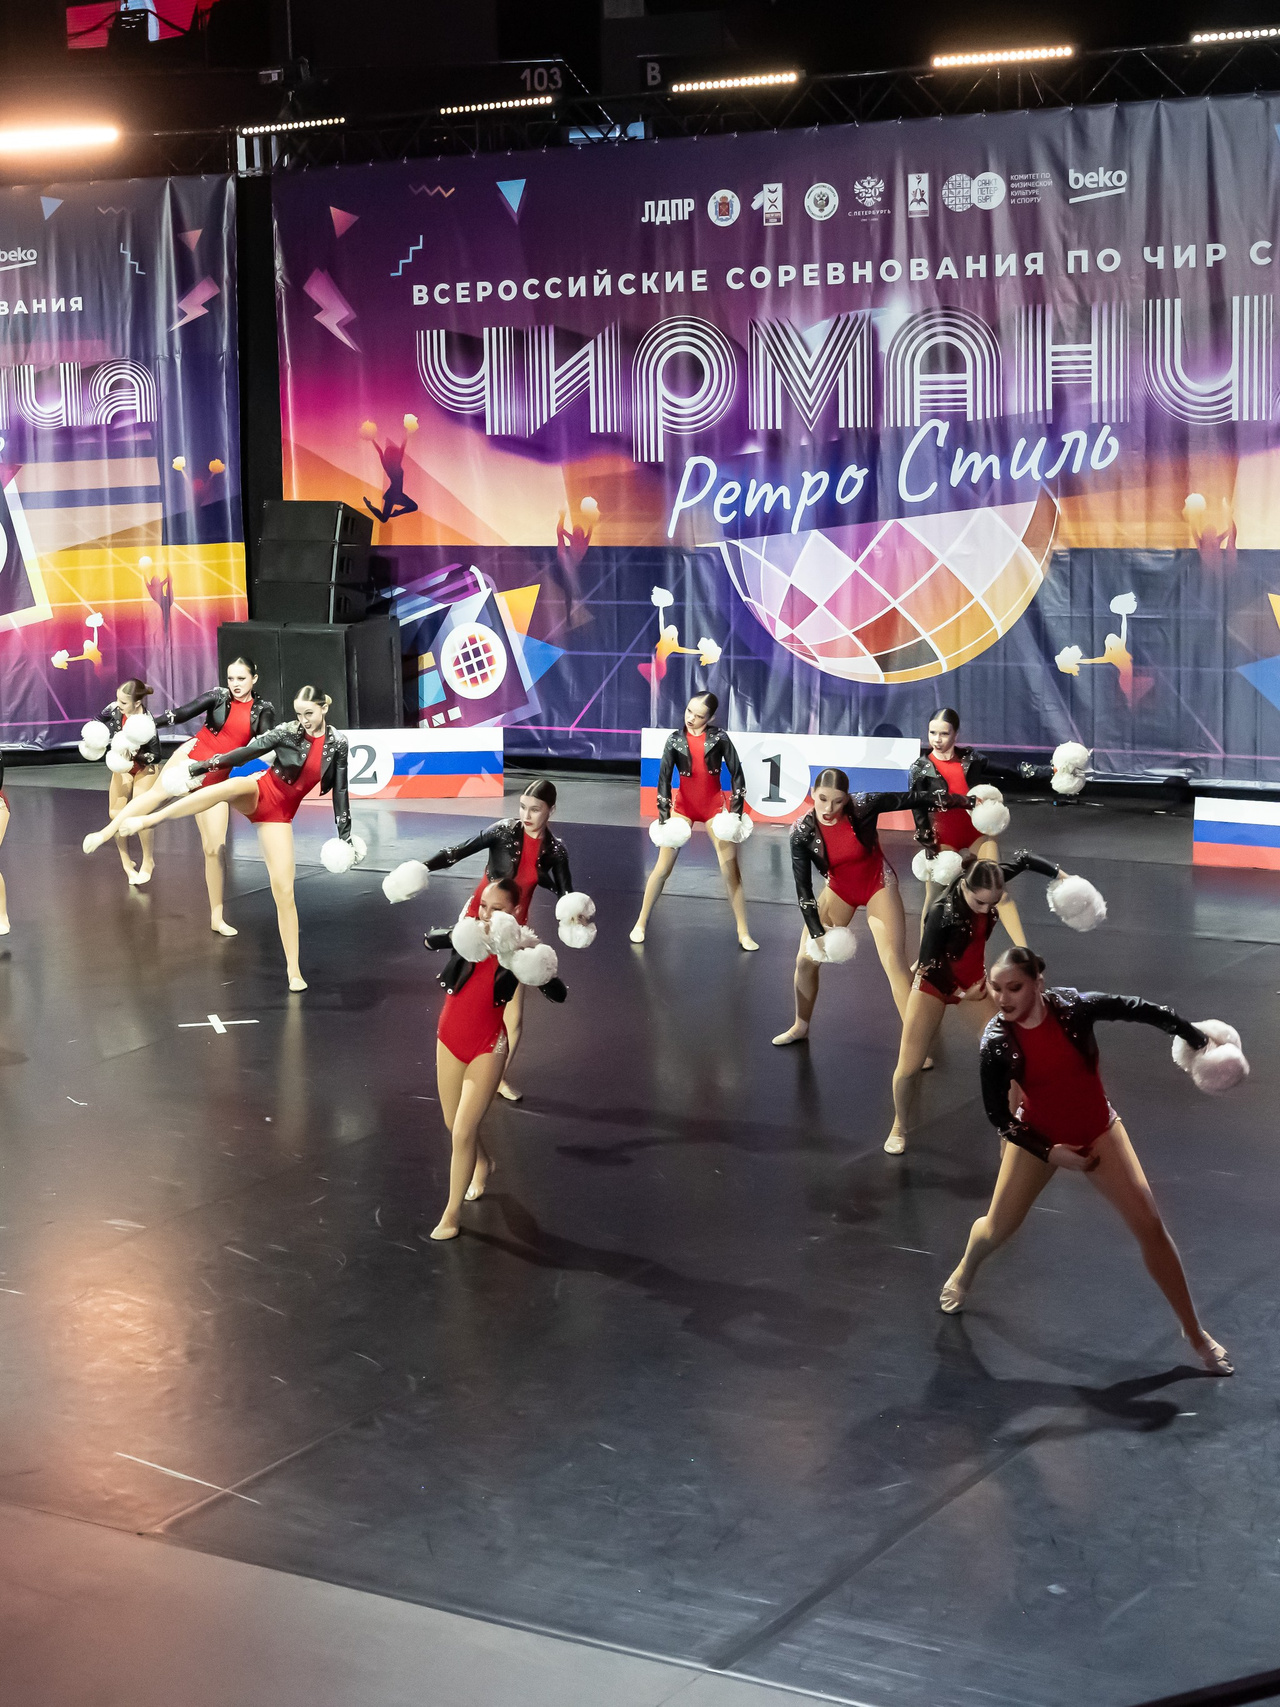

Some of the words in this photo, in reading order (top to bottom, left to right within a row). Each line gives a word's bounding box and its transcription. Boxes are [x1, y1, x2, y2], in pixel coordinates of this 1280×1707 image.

[520, 67, 563, 92] 103
[1010, 179, 1053, 188] ФИЗИЧЕСКОЙ
[1069, 167, 1128, 190] beko
[641, 198, 695, 225] ЛДПР
[412, 268, 709, 306] ВСЕРОССИЙСКИЕ
[725, 251, 1045, 290] СОРЕВНОВАНИЯ
[1067, 247, 1122, 274] ПО
[1143, 243, 1227, 270] ЧИР
[666, 455, 870, 539] Ретро
[897, 418, 1120, 503] Стиль
[349, 744, 378, 785] 2
[761, 753, 787, 803] 1
